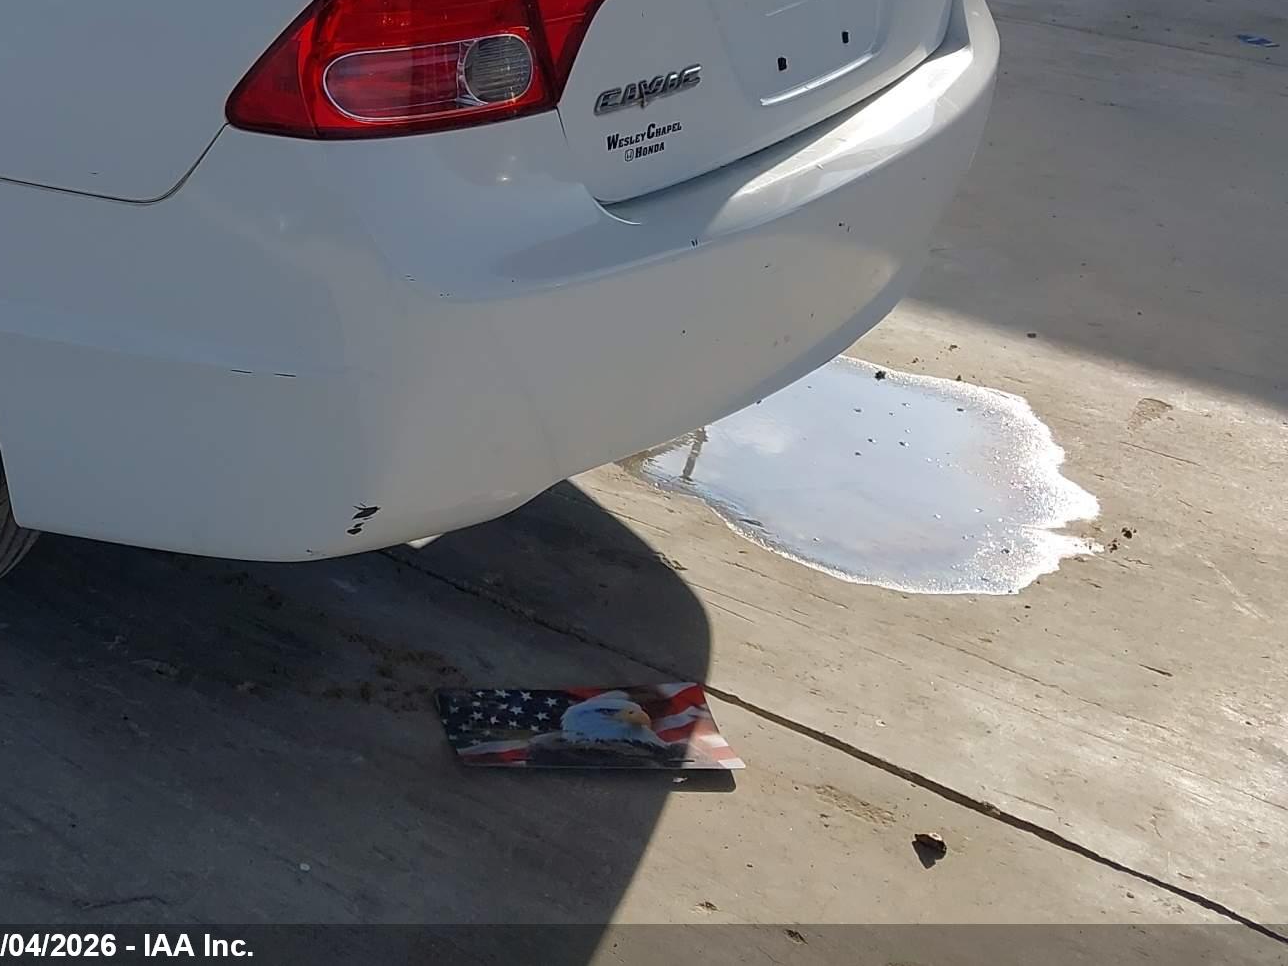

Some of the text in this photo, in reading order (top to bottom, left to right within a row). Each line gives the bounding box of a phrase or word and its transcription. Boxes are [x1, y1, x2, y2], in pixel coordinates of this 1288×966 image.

[606, 122, 682, 151] WESLEY CHAPEL
[635, 142, 665, 159] HONDA
